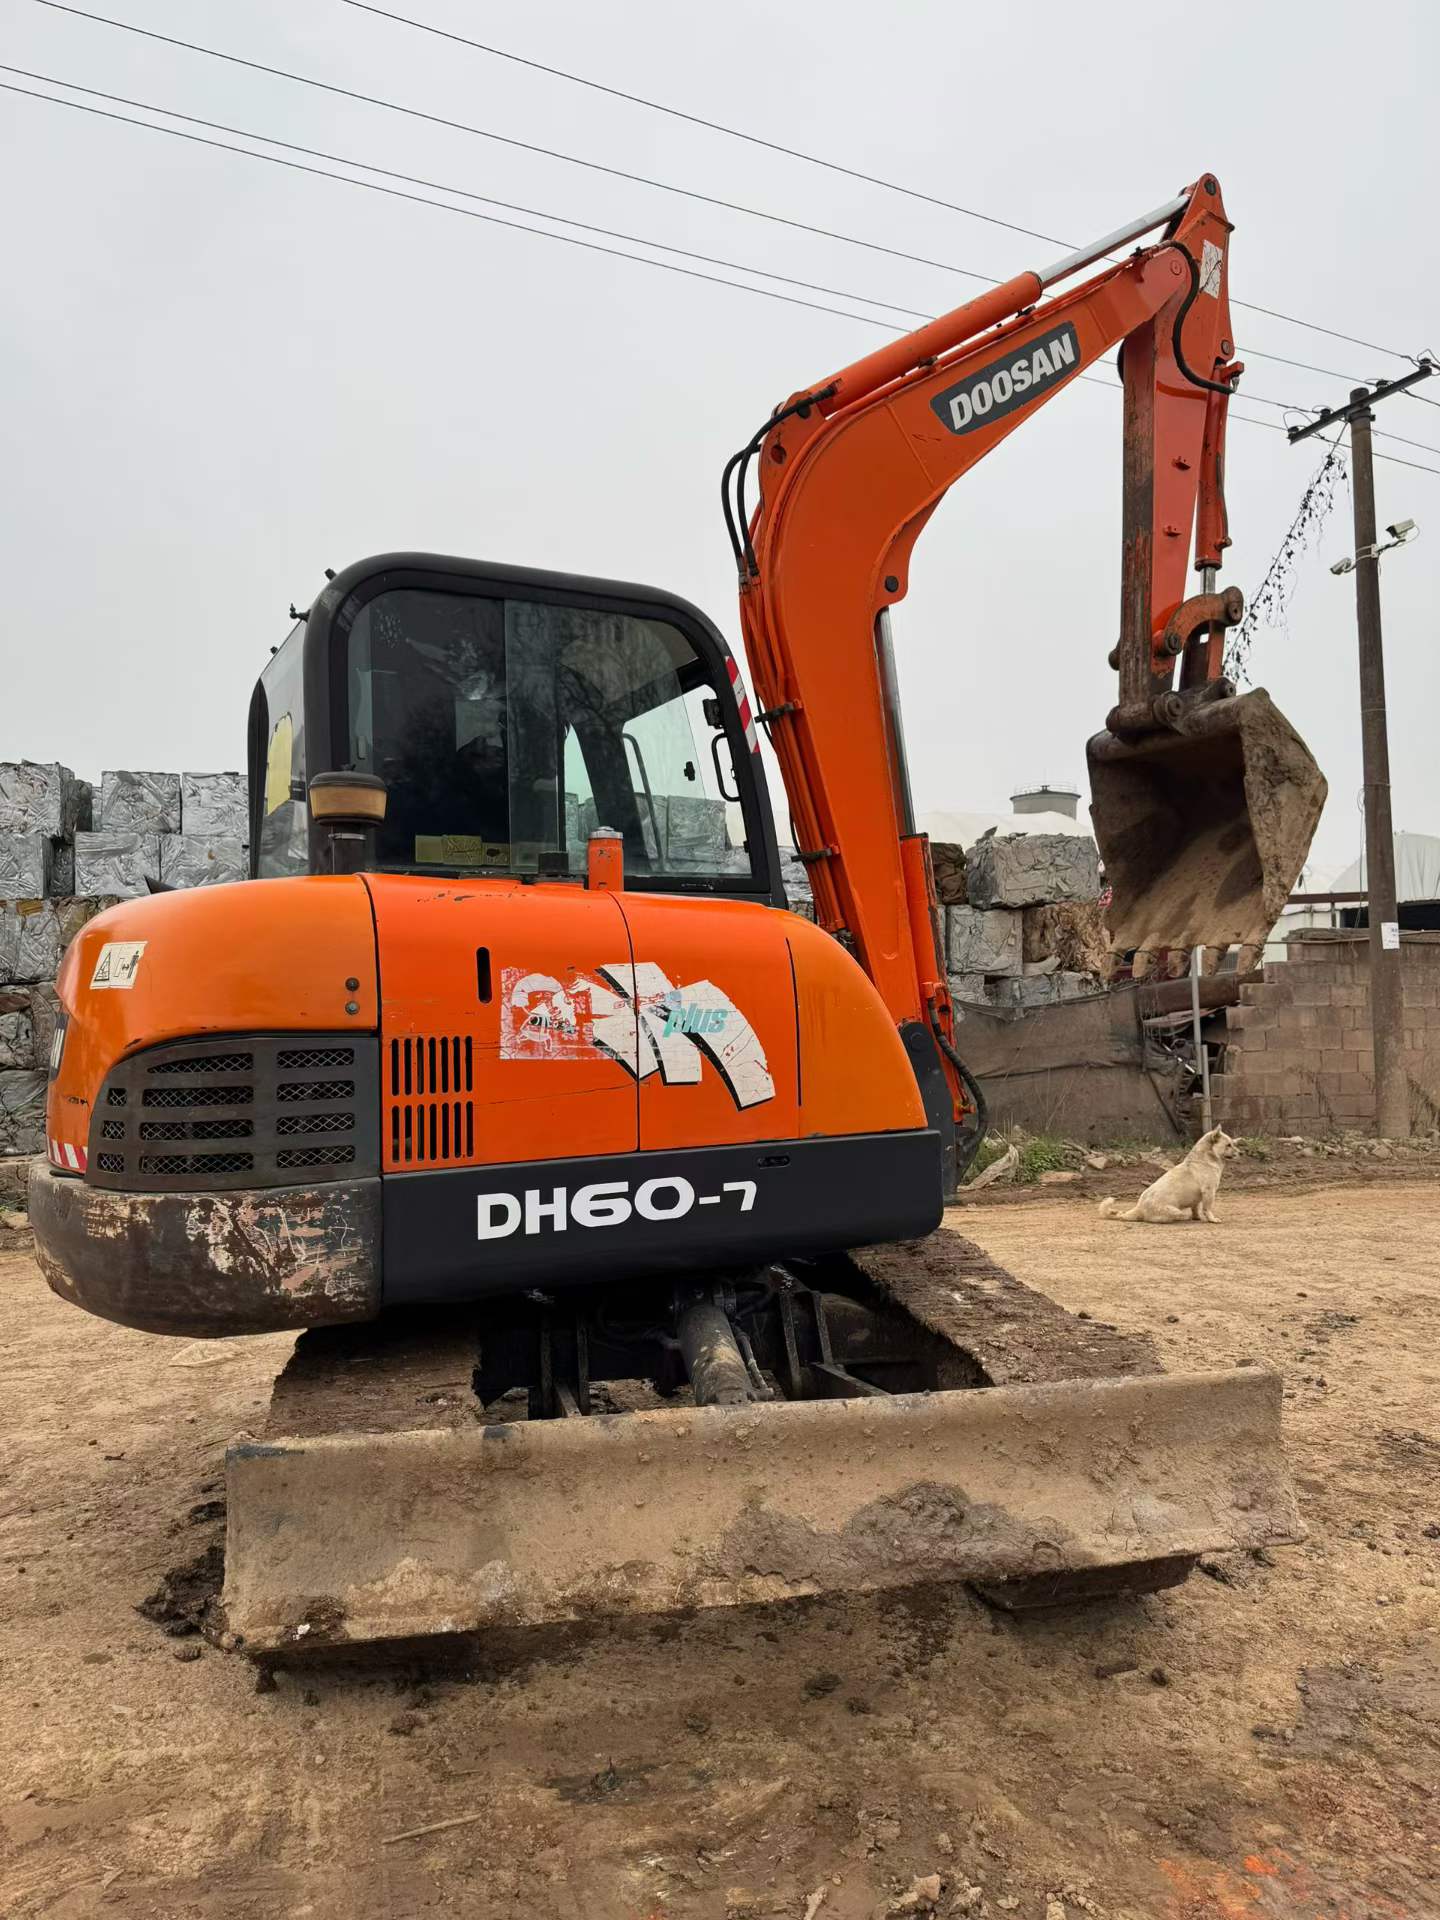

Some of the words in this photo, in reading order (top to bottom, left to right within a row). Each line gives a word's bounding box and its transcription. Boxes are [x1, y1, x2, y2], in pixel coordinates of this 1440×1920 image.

[949, 333, 1075, 430] DOOSAN
[663, 1003, 728, 1038] plus
[477, 1176, 757, 1240] DH60-7
